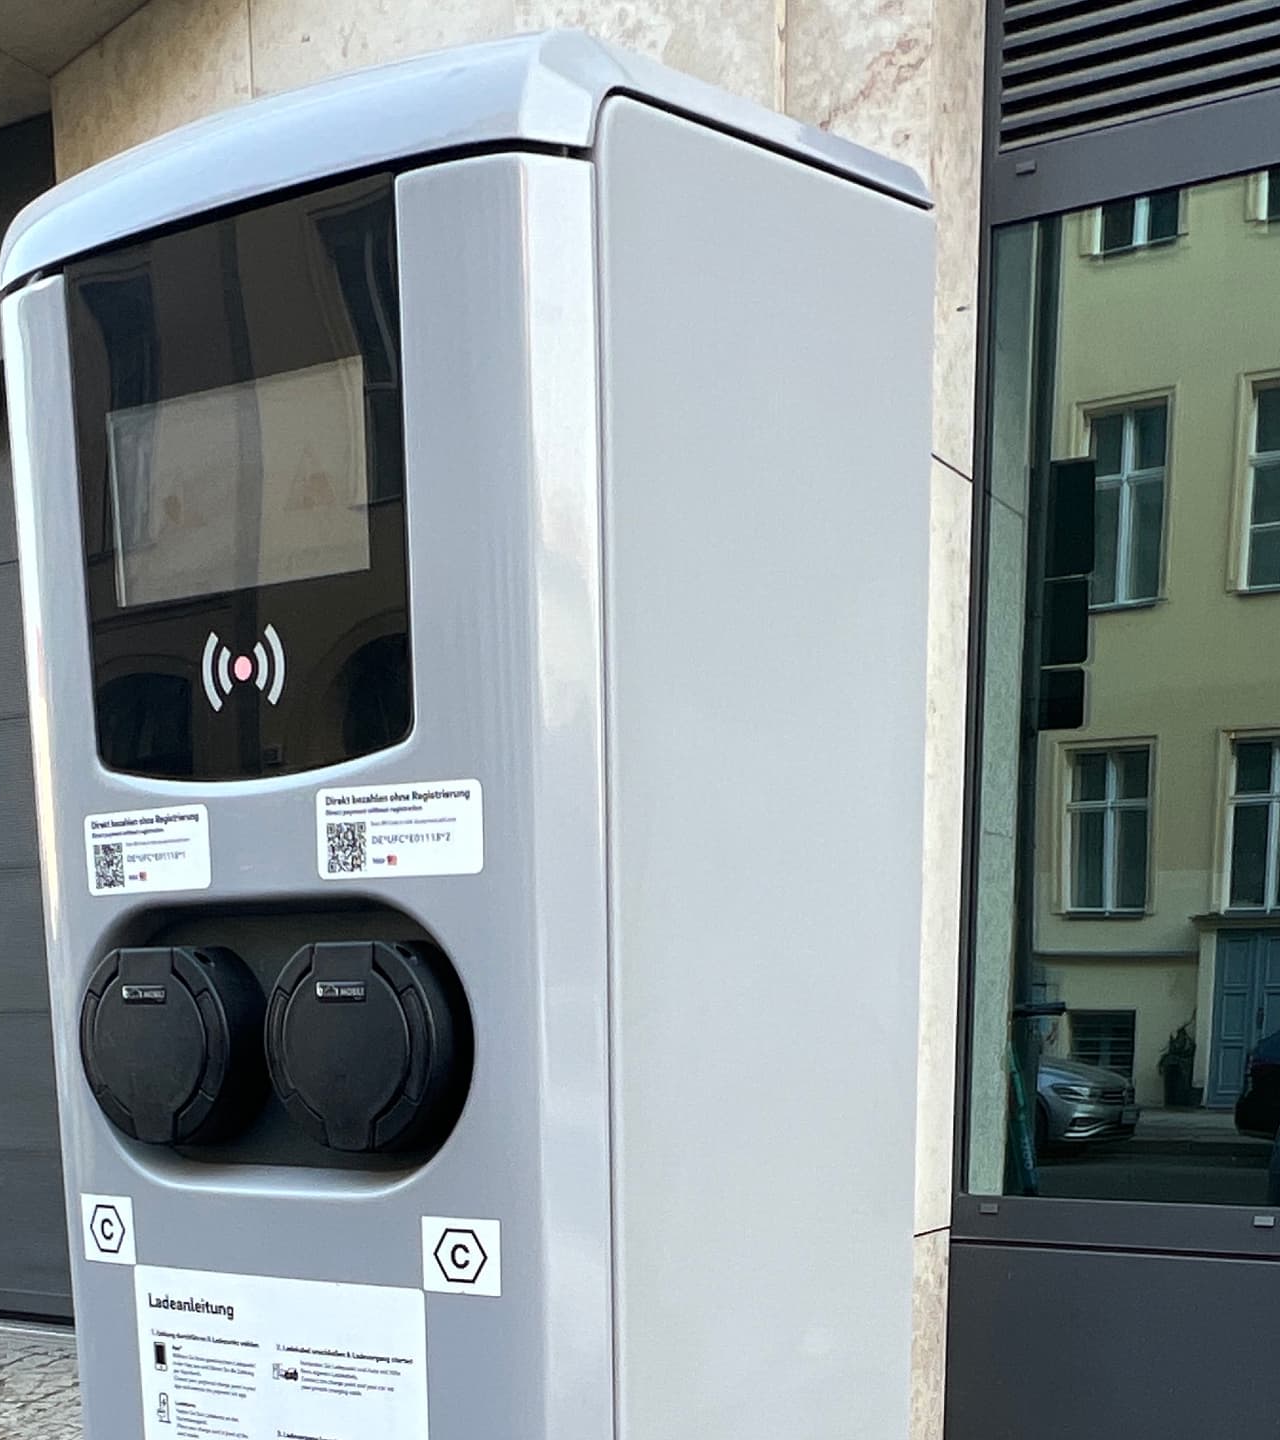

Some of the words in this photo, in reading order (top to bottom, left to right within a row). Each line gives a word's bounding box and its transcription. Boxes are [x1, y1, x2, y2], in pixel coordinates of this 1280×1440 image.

[325, 795, 350, 806] Direkt
[352, 793, 388, 805] bezahlen
[390, 792, 410, 802] ohne
[411, 789, 471, 803] Registrierung
[100, 1217, 115, 1240] C
[450, 1243, 470, 1270] C
[147, 1292, 234, 1321] Ladeanleitung
